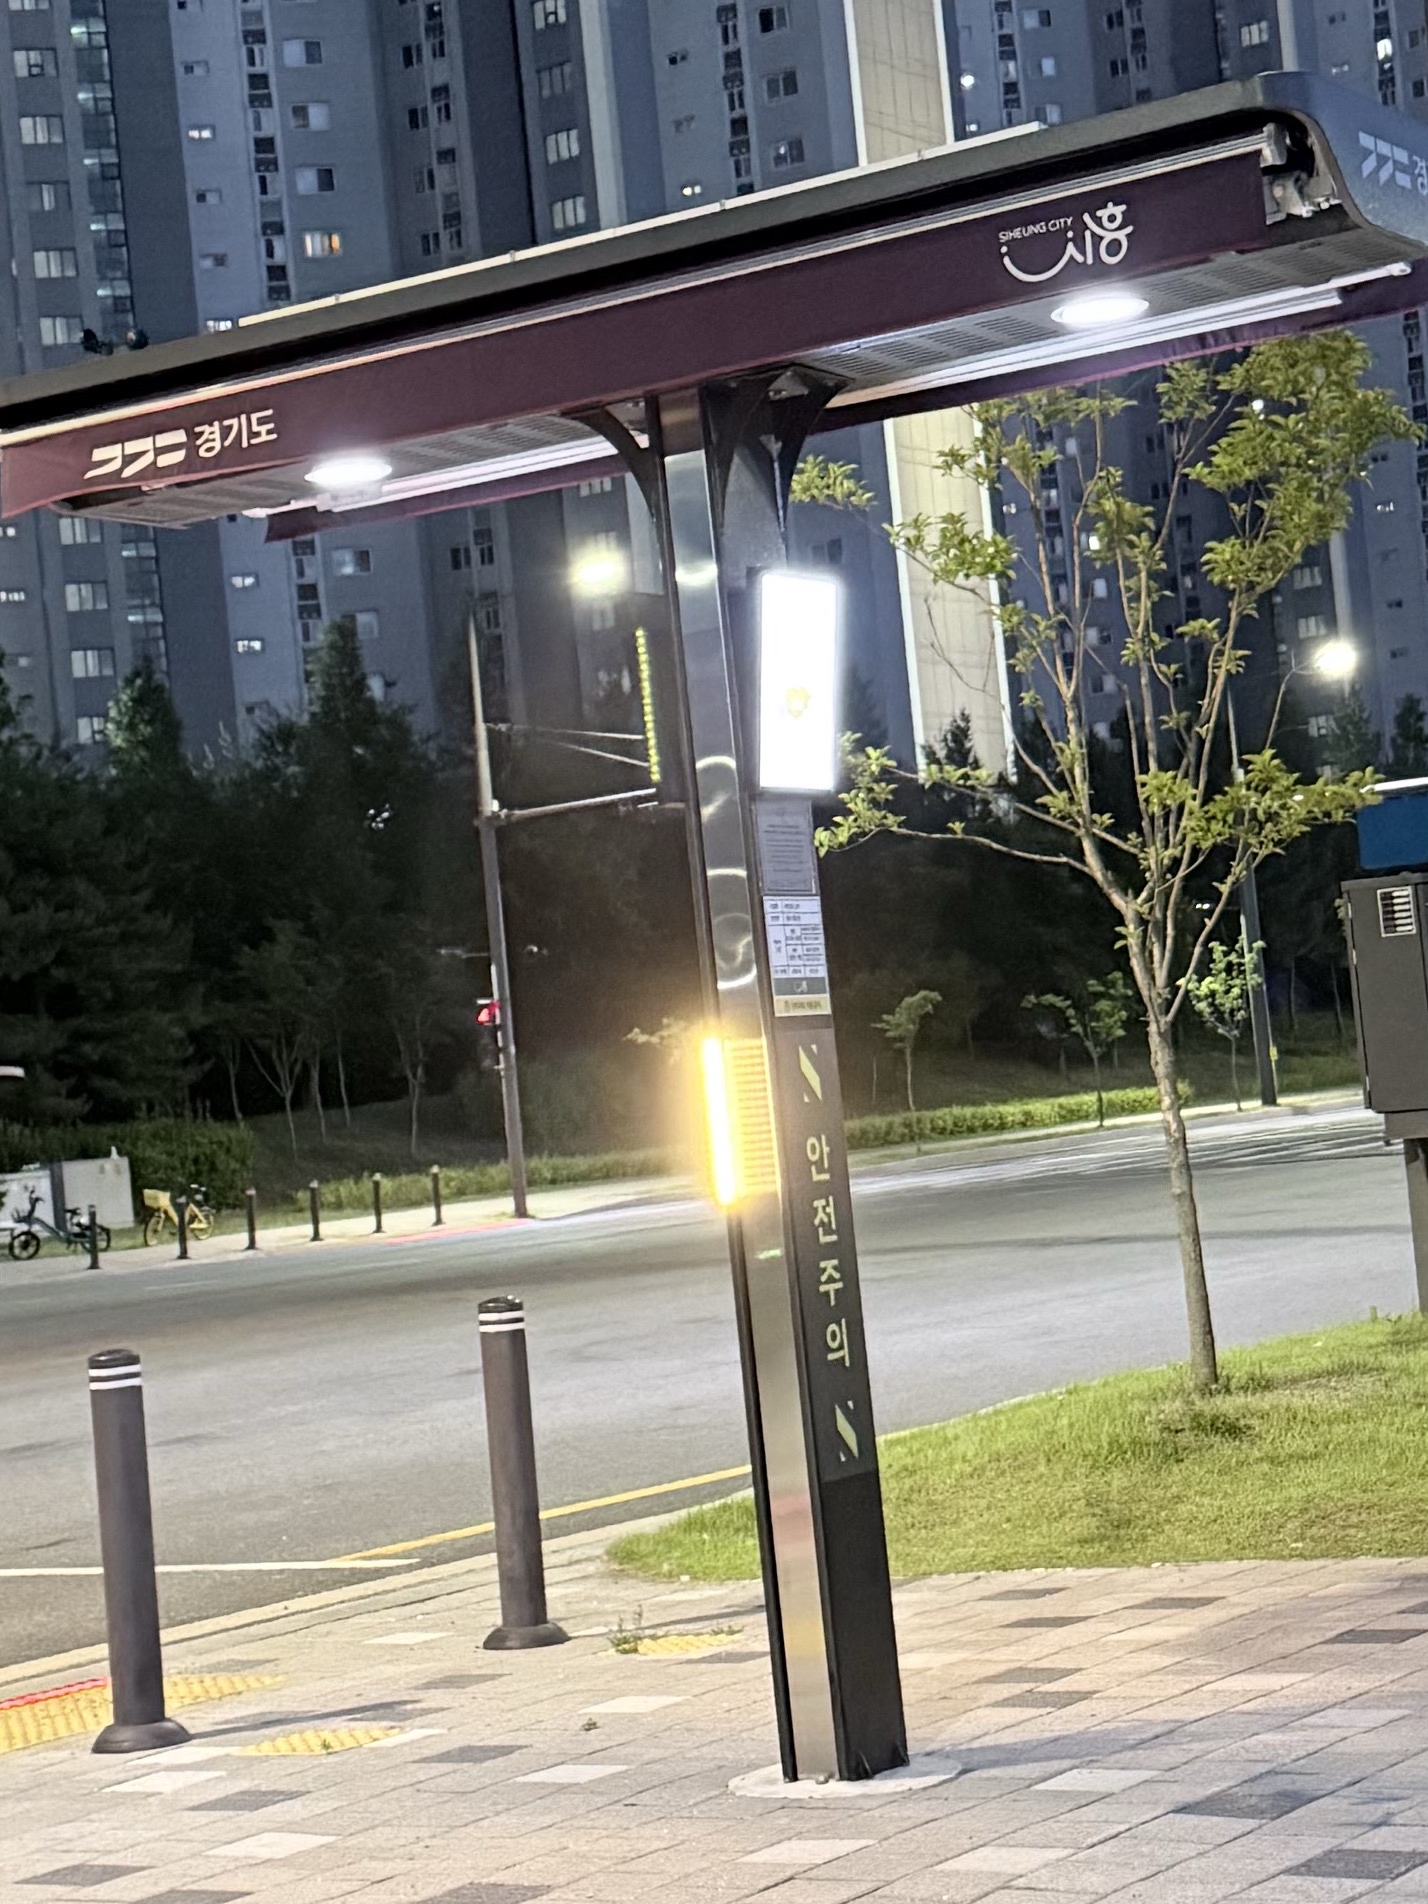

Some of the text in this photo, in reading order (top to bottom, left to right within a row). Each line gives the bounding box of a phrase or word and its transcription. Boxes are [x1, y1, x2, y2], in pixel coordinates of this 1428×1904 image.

[998, 216, 1073, 243] SIHEUNG CITY
[193, 409, 278, 458] 경기도
[806, 1134, 850, 1368] 안전주의
